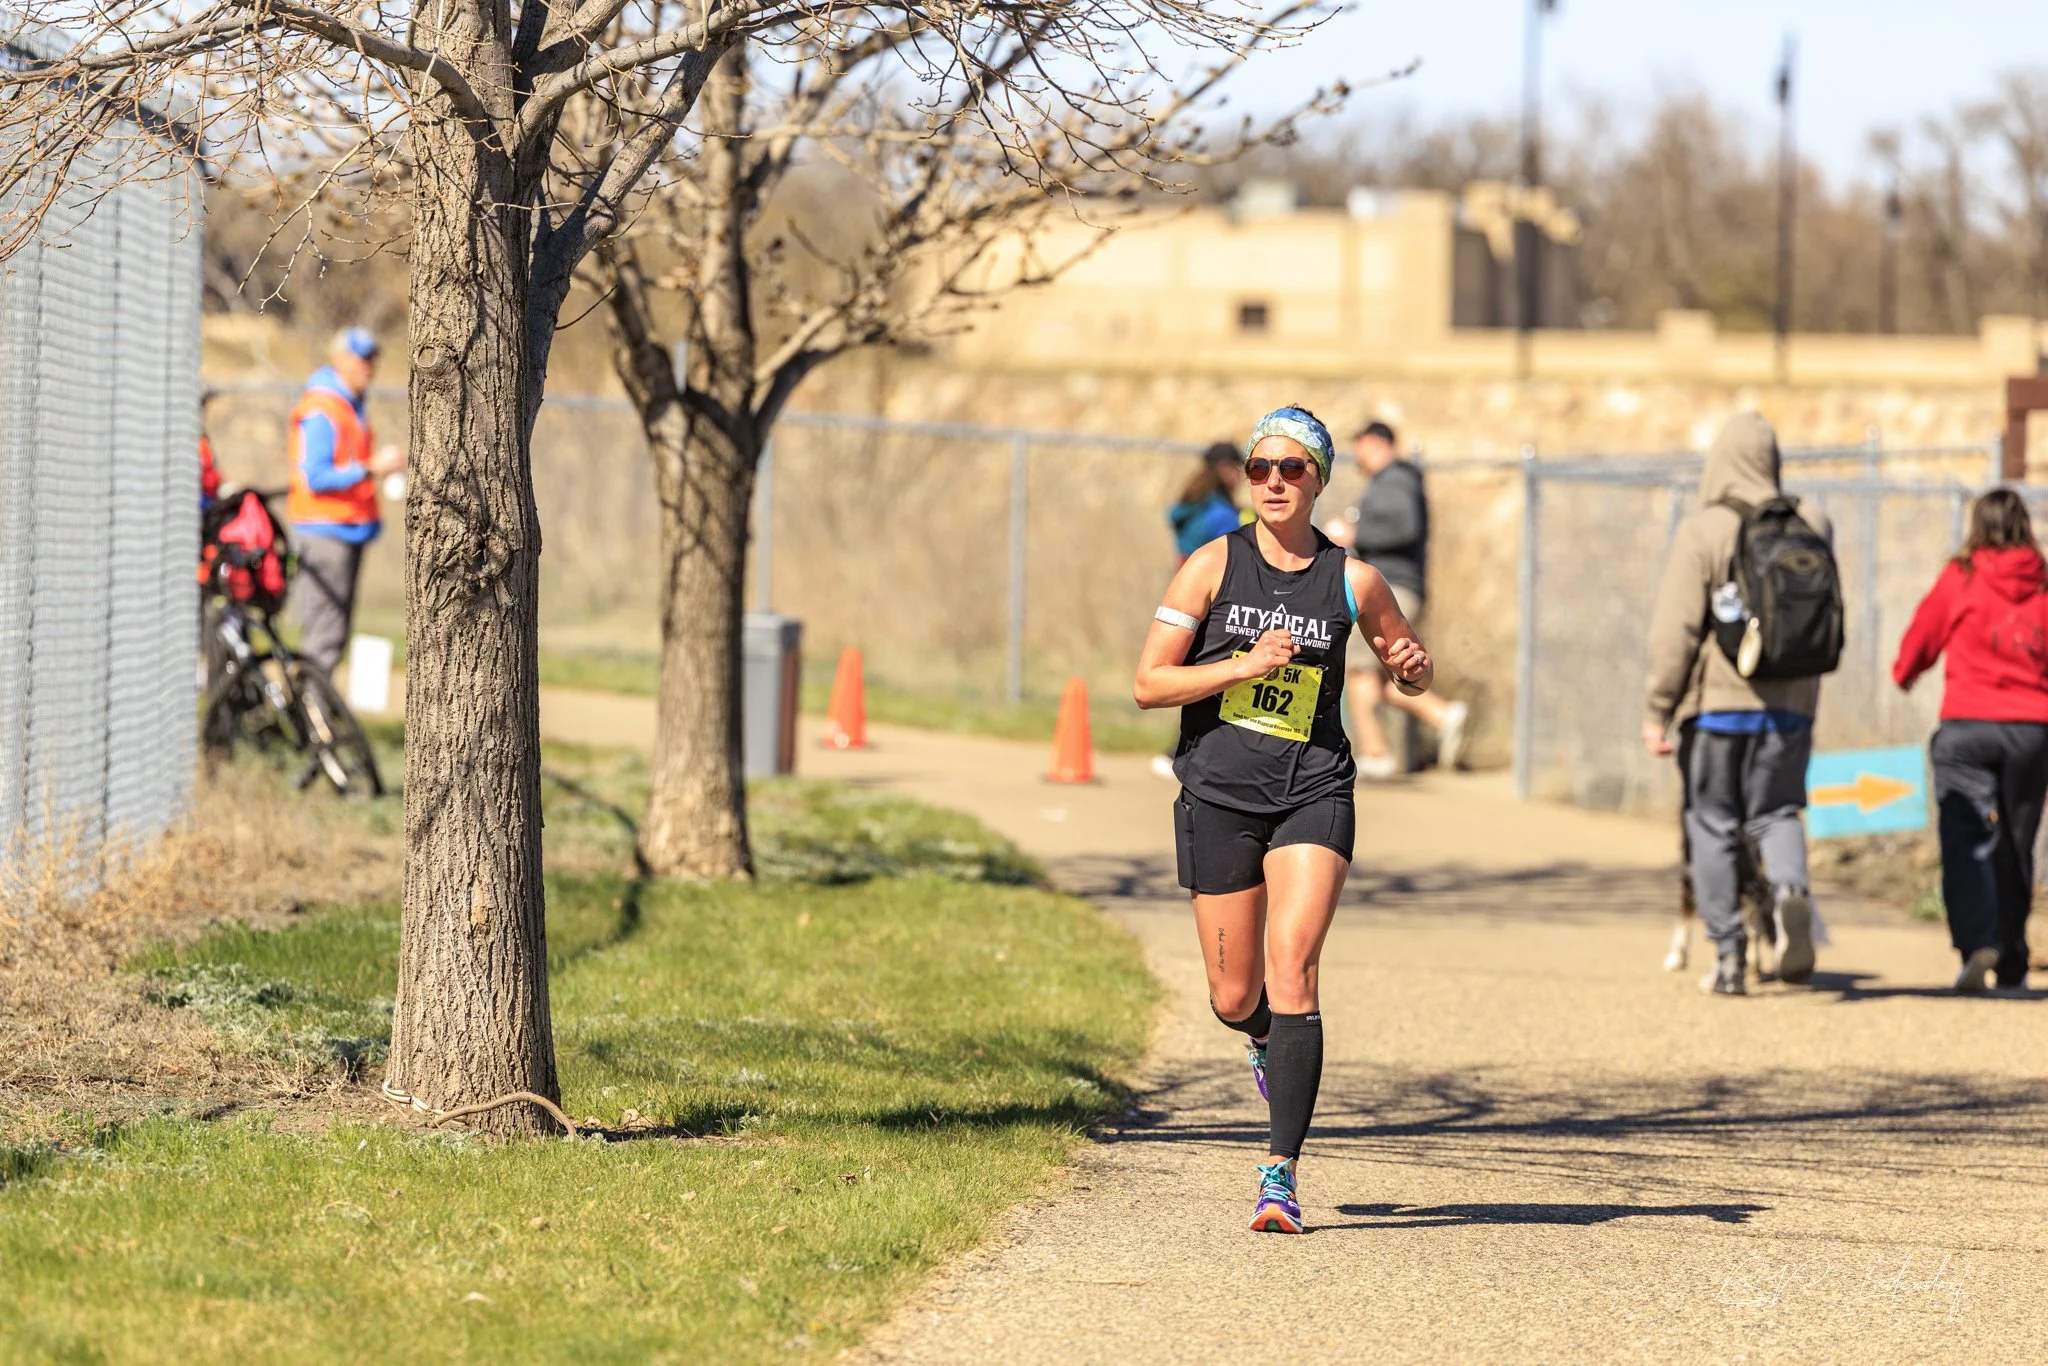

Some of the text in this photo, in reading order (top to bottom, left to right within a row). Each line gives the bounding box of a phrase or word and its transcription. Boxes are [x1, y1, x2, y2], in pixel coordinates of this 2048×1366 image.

[1225, 624, 1261, 637] BREWERY
[1226, 604, 1332, 641] ATYPICAL
[1283, 667, 1302, 684] 5K
[1252, 683, 1293, 716] 162
